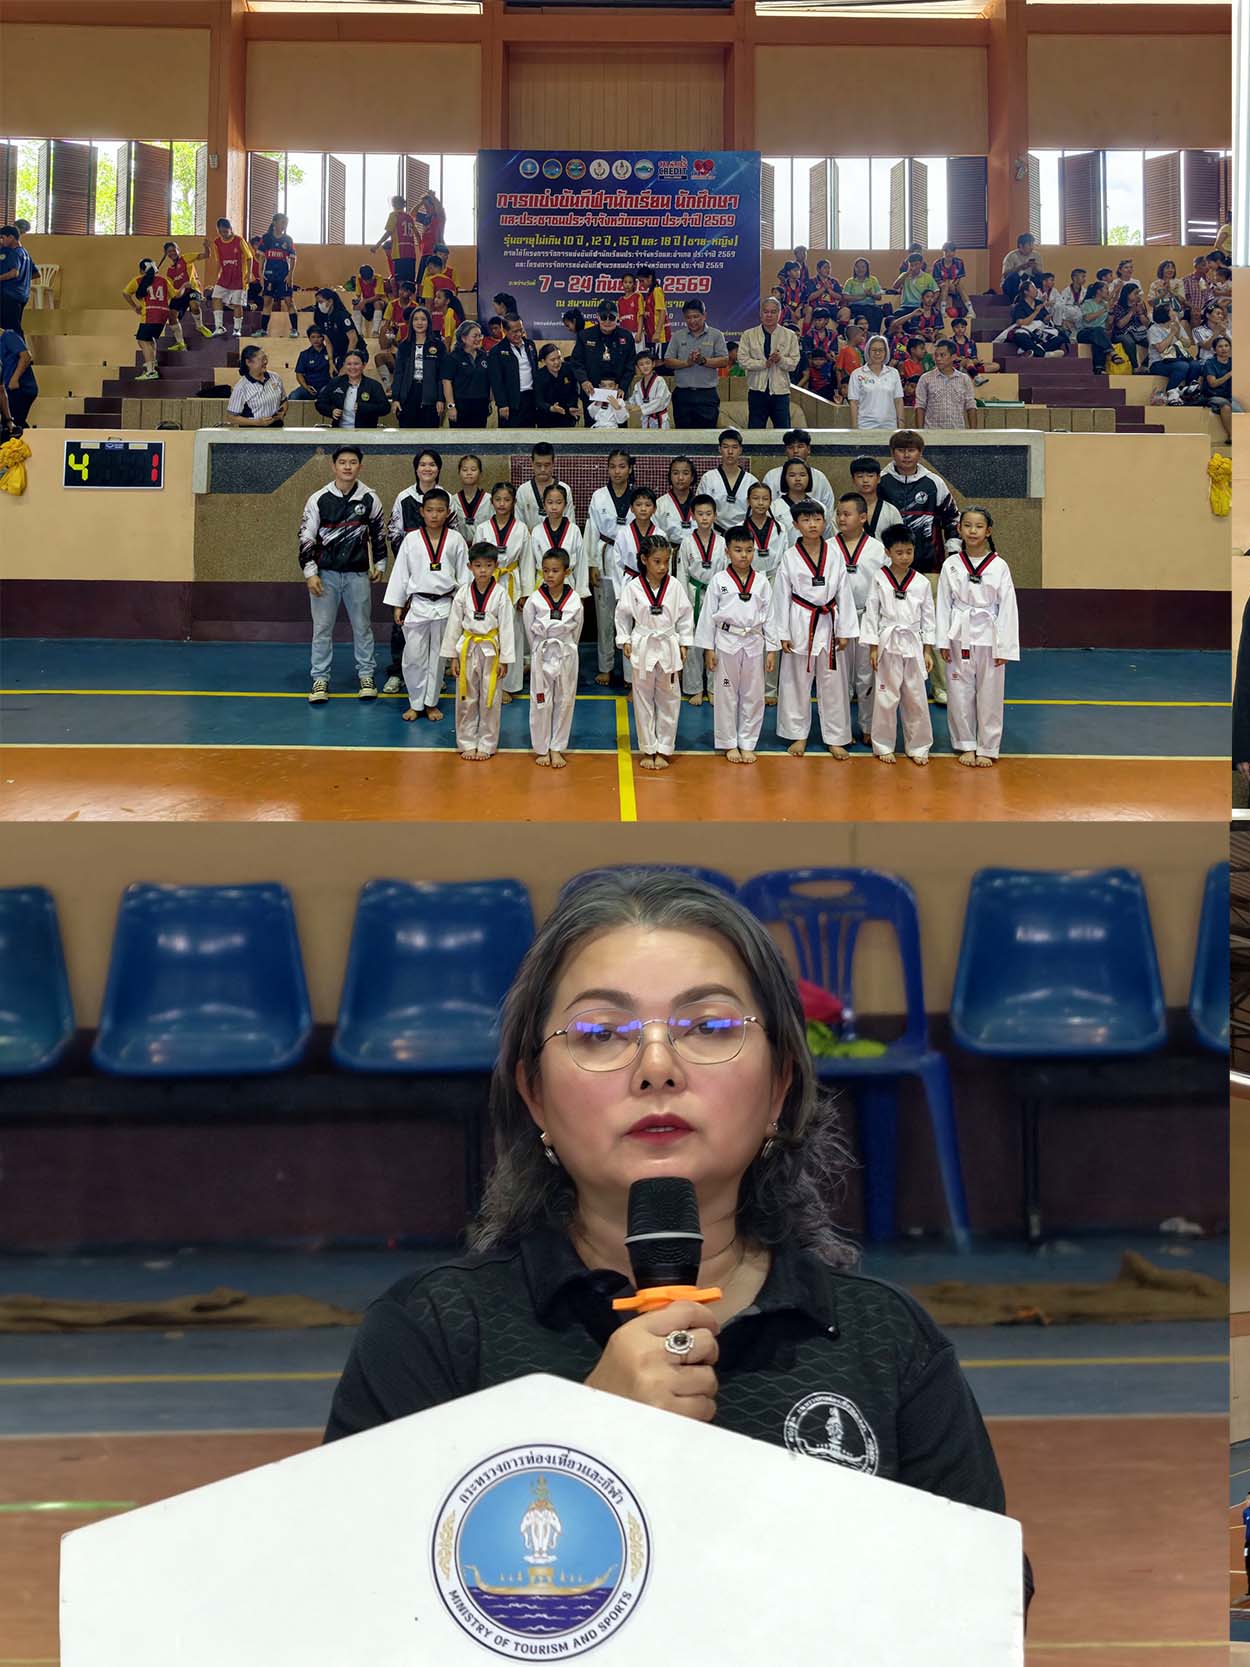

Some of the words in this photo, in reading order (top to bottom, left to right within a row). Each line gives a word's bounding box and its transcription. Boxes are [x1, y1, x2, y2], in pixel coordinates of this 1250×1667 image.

[703, 214, 736, 227] 2569
[591, 236, 601, 246] 12
[619, 236, 629, 246] 15
[146, 286, 164, 301] 14
[539, 274, 552, 294] 7
[568, 275, 593, 293] 24
[662, 276, 712, 293] 2569
[68, 453, 89, 481] 4
[151, 453, 159, 481] 1
[459, 1450, 625, 1505] กระทรวงการท่องเที่ยวและกีฬา
[448, 1589, 491, 1639] MINISTRY
[494, 1633, 510, 1648] OF
[513, 1641, 569, 1656] TOURISM
[573, 1628, 599, 1649] AND
[599, 1590, 633, 1632] SPORTS
